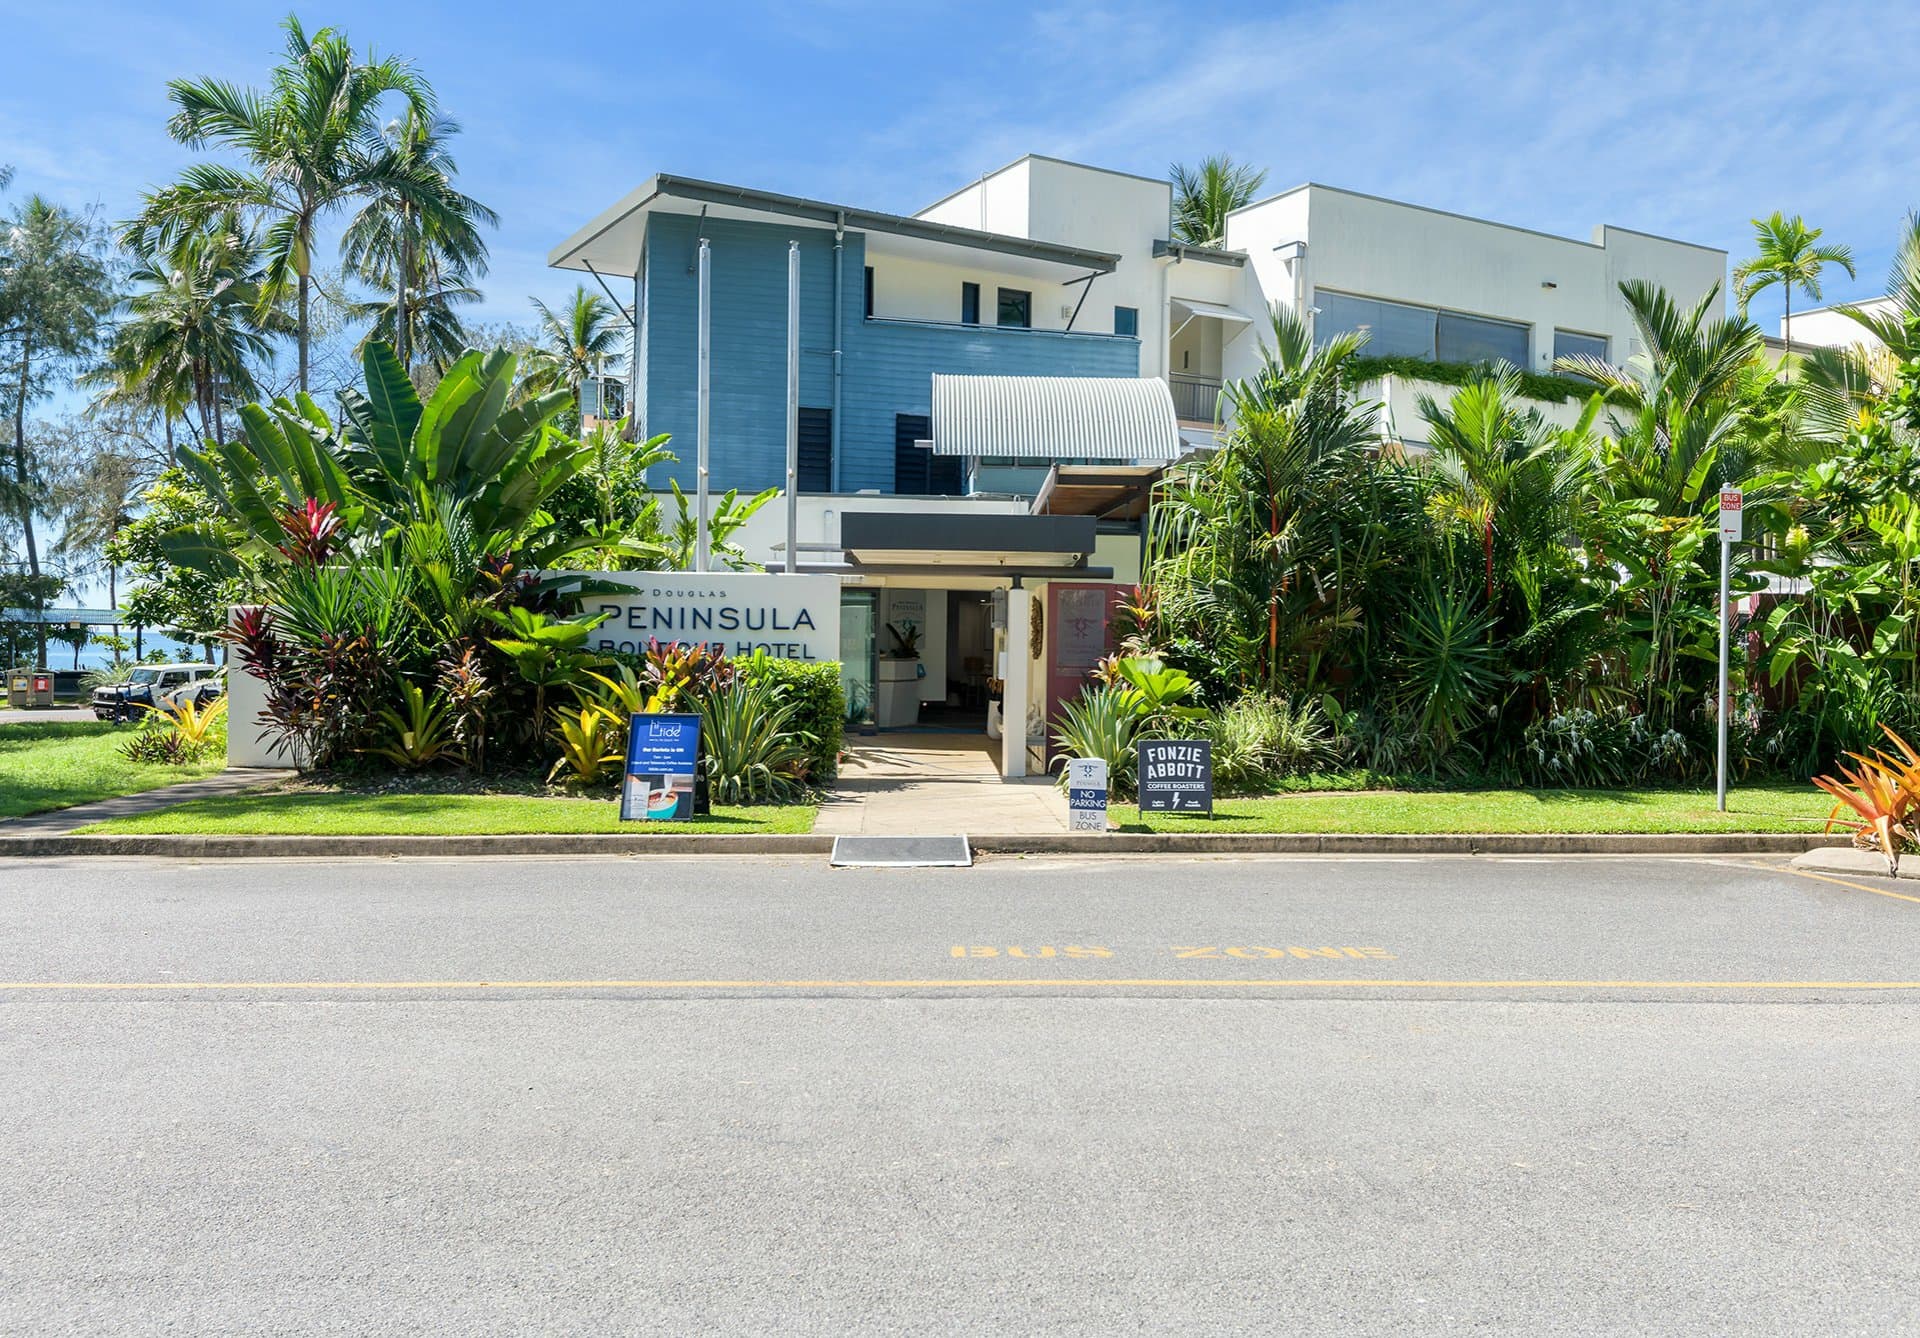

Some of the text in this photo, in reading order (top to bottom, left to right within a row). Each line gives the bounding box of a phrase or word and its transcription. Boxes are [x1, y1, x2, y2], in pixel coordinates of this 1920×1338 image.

[1721, 502, 1741, 510] ZONE
[652, 588, 728, 598] DOUGLAS
[600, 604, 817, 631] PENINSULA
[599, 639, 816, 659] BOUQE HOTEL
[1147, 746, 1203, 762] FONZIE
[1148, 763, 1204, 779] ABBOTT
[1080, 790, 1096, 799] NO
[1070, 798, 1106, 808] PARKING
[1080, 811, 1097, 820] BUS
[1075, 821, 1102, 831] ZONE
[950, 945, 1399, 960] BUS ZONE
